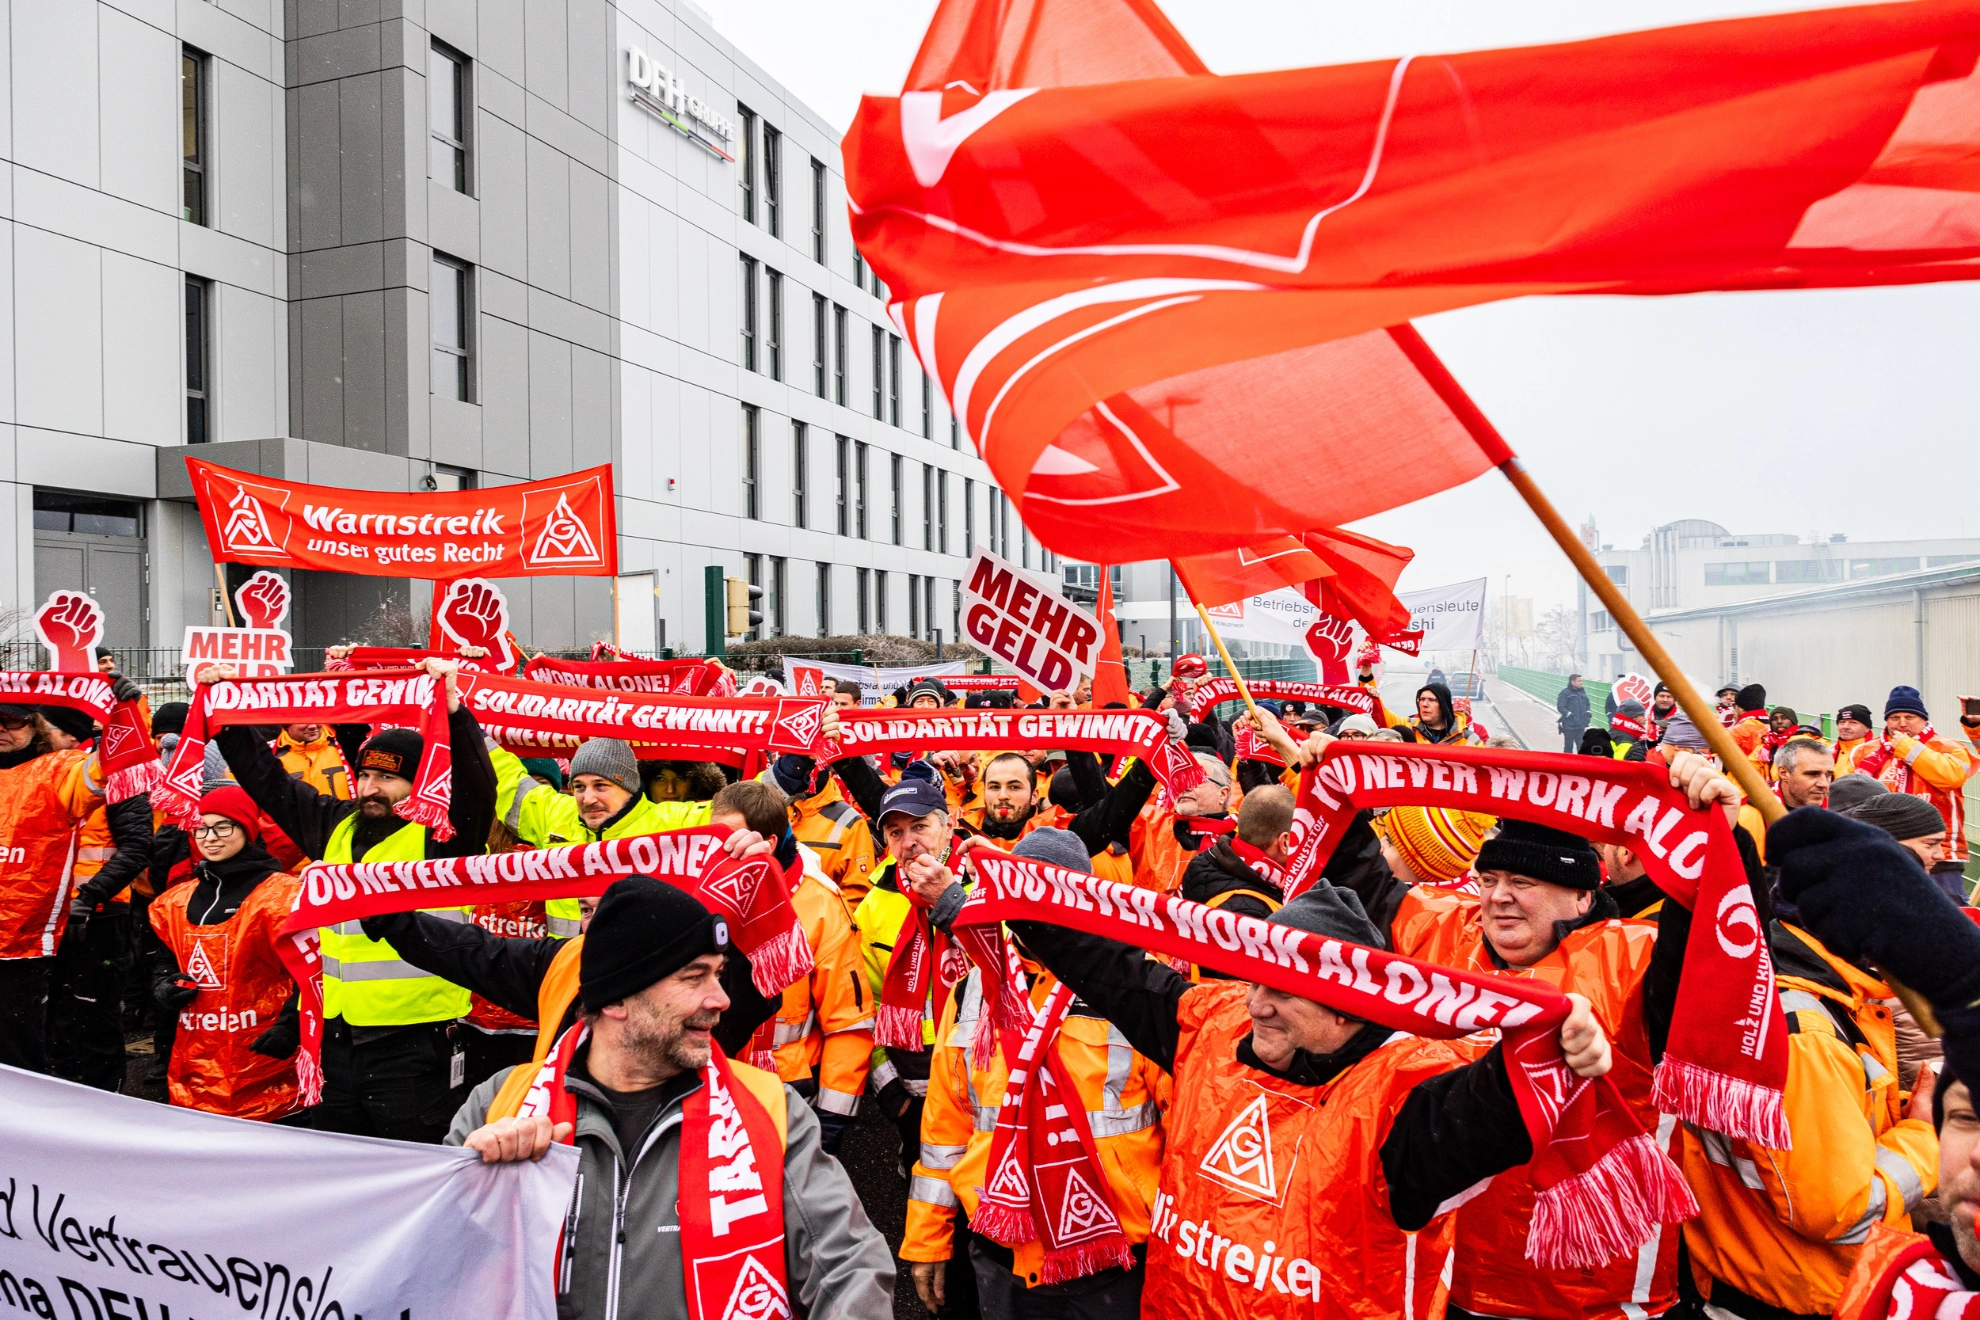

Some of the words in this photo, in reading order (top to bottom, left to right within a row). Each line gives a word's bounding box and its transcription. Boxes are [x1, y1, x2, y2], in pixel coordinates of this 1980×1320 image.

[629, 44, 685, 115] DFH
[688, 96, 735, 142] GRUPPE
[302, 504, 506, 536] Warnstreik
[307, 538, 369, 559] unser
[374, 543, 437, 565] gutes
[443, 541, 506, 563] Recht
[967, 555, 1098, 666] MEHR
[189, 631, 287, 661] MEHR
[966, 603, 1073, 691] GELD
[35, 672, 118, 715] ALONE!
[594, 674, 670, 693] ALONE!
[861, 695, 881, 706] irma
[1216, 679, 1271, 696] NEER
[1275, 681, 1329, 699] WORK
[473, 687, 634, 726] SOLIDARITÄT
[632, 704, 771, 735] GEWINNT!
[838, 711, 1013, 745] SOLIDARITÄT
[1017, 712, 1163, 747] GEWINNT!
[1310, 754, 1357, 812] YOU
[1358, 754, 1478, 795] NEVER
[1482, 765, 1628, 829] WORK
[1289, 814, 1327, 876] KUNSTSTOFF
[353, 857, 463, 895] NEVER
[464, 845, 580, 885] WORK
[981, 858, 1048, 903] YOU
[1043, 865, 1165, 931] NEVER
[1166, 896, 1310, 974] WORK
[1748, 983, 1767, 1018] UND
[1740, 1018, 1760, 1057] HOLZ
[32, 1183, 412, 1320] Vertrauensl
